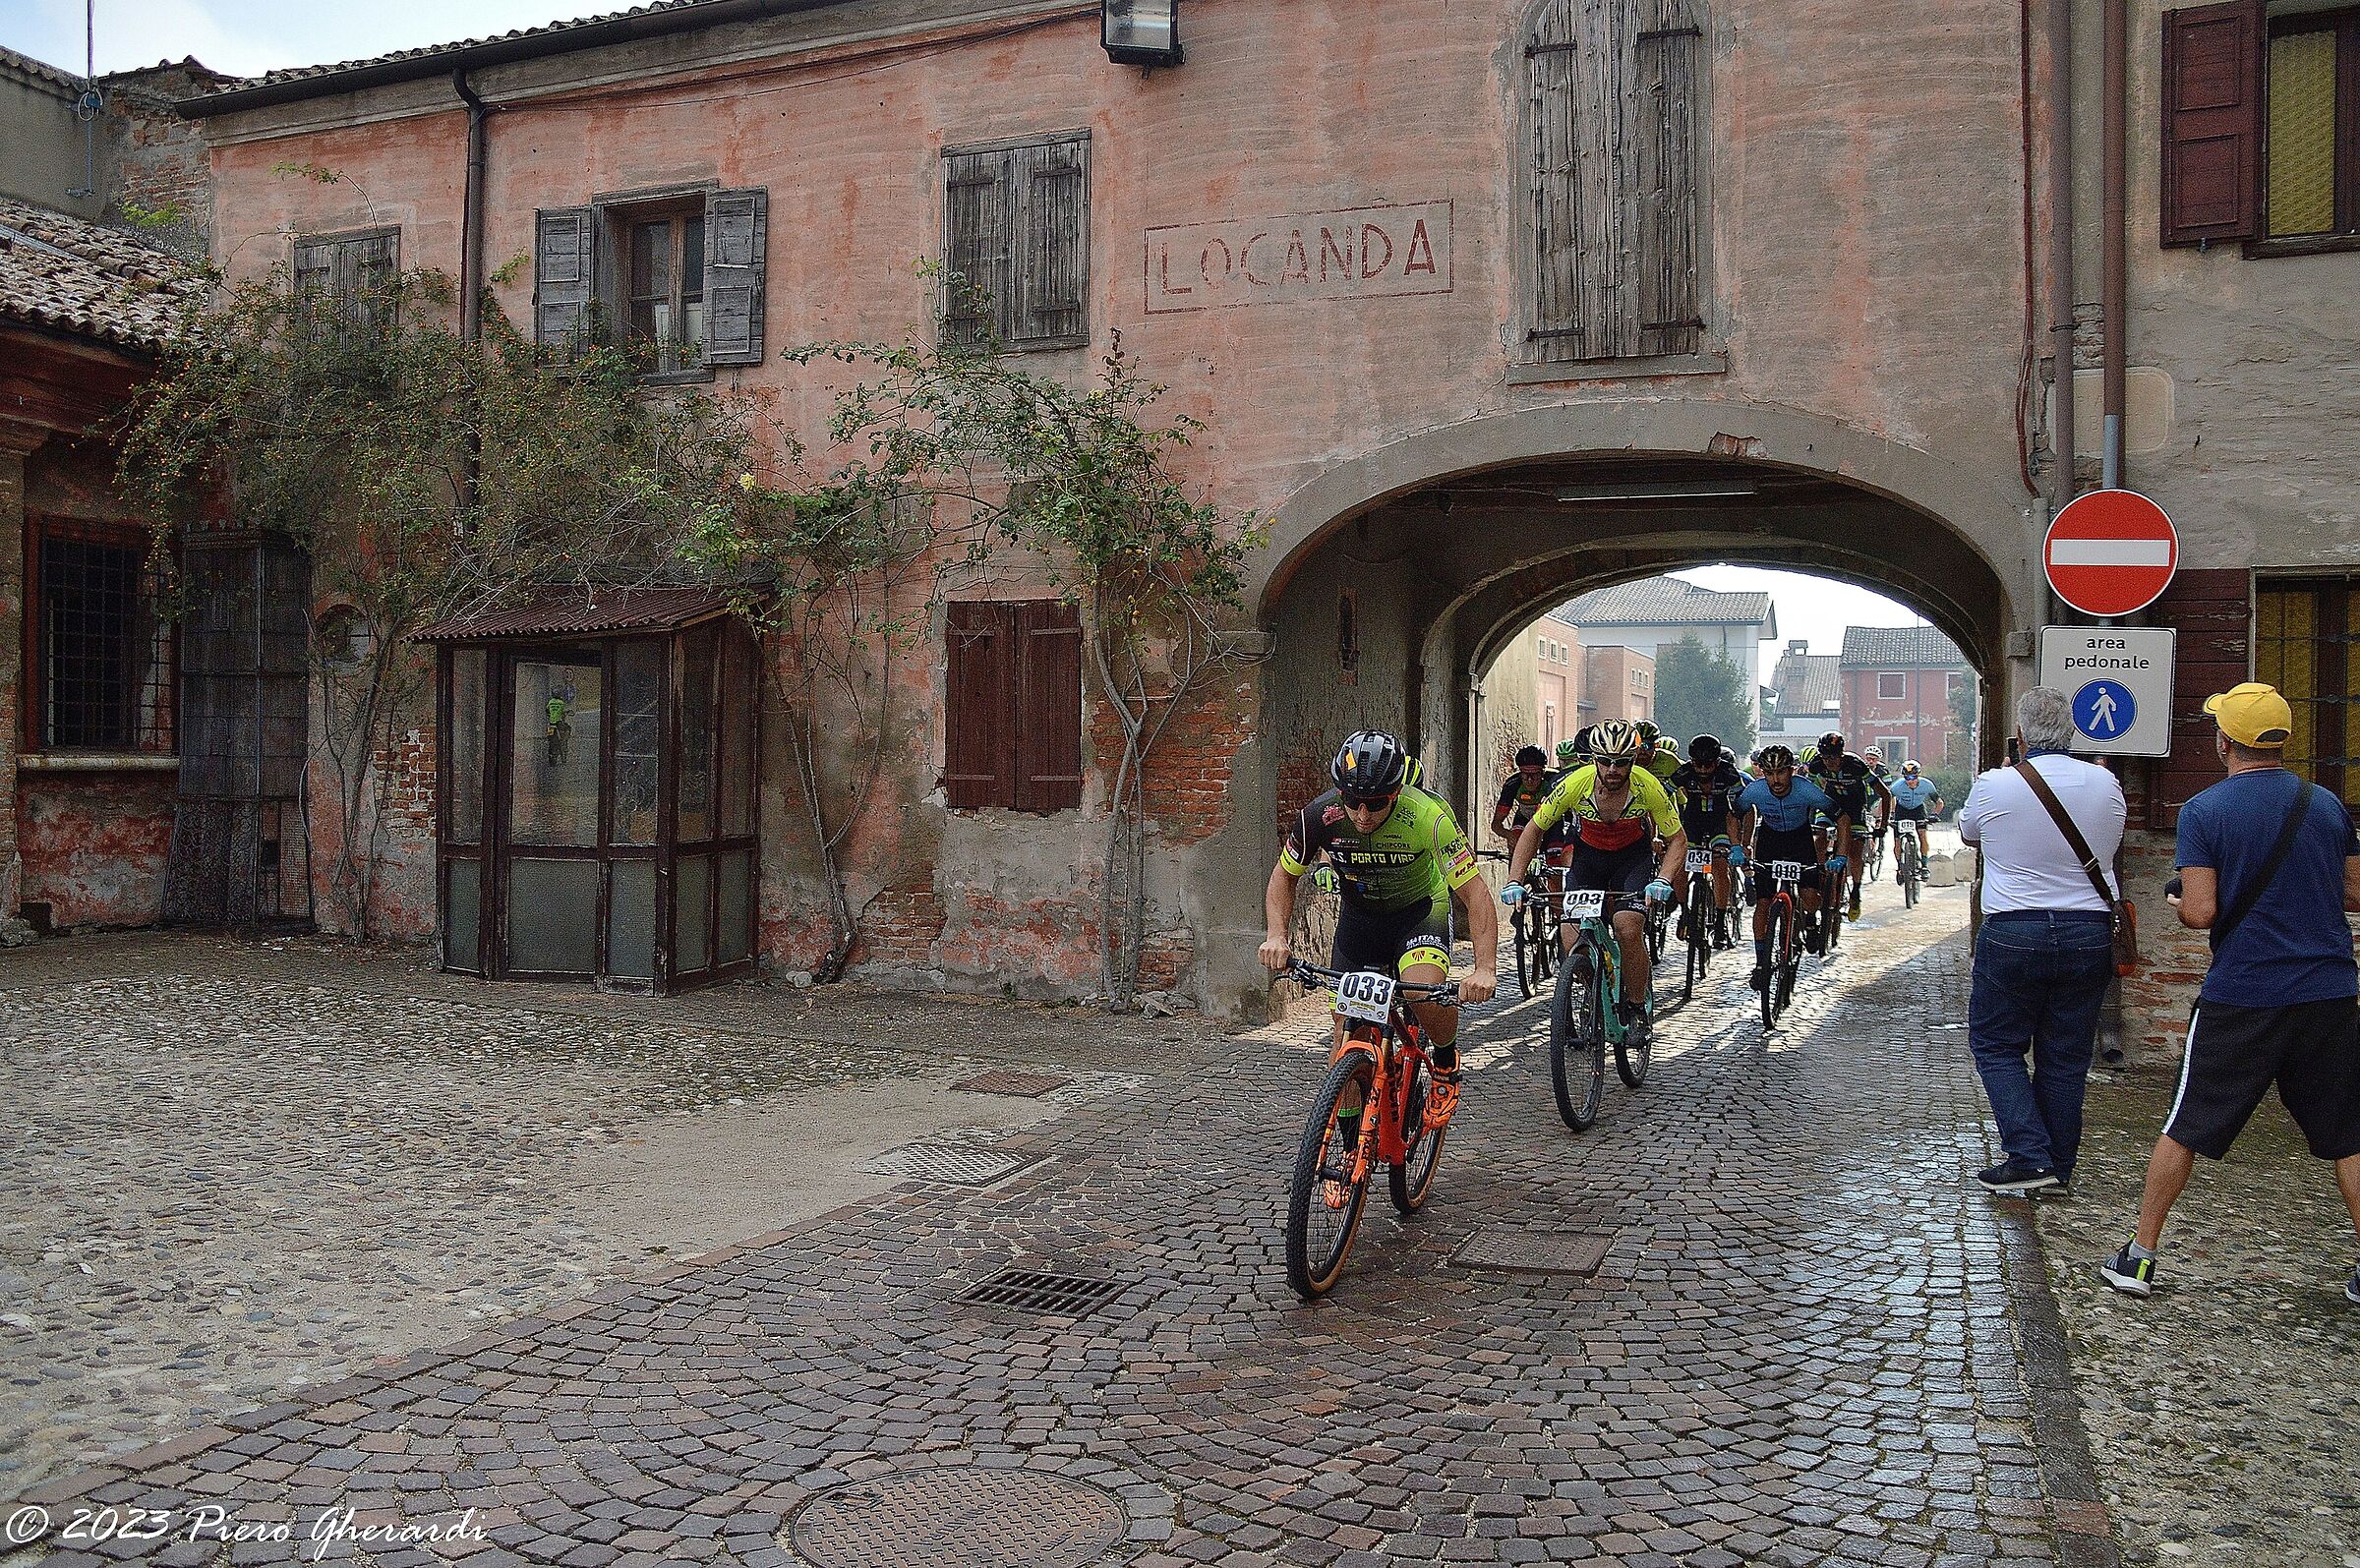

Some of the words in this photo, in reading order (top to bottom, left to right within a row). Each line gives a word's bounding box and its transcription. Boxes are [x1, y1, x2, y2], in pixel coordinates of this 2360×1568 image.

[1161, 218, 1437, 296] LOCANDA
[2086, 638, 2126, 650] area
[2064, 654, 2150, 670] pedonale
[1350, 852, 1386, 864] PORTO
[1389, 853, 1415, 864] VIRO
[1687, 851, 1711, 864] 034
[1774, 863, 1798, 879] 018
[1566, 893, 1602, 905] 003
[1342, 974, 1391, 1006] 033
